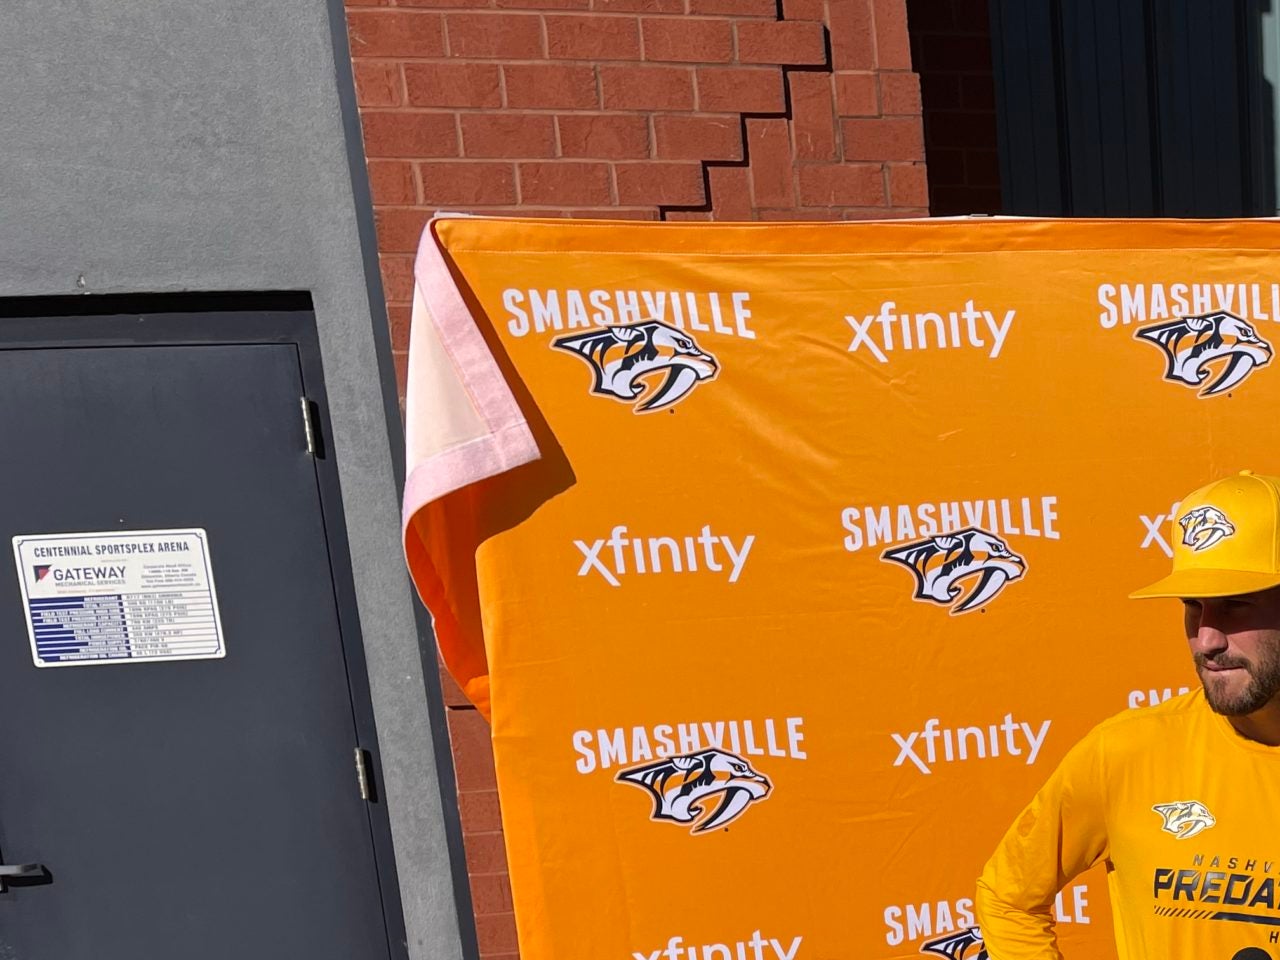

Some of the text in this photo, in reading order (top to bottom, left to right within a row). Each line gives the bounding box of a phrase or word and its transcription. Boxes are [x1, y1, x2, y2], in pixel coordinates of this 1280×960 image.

[502, 287, 757, 340] SMASHVILLE
[844, 299, 1017, 363] xfinity
[34, 540, 190, 558] CENTENNIAL SPORTSPLEX ARENA
[841, 495, 1061, 552] SMASHVILLE
[53, 566, 126, 581] GATEWAY
[573, 524, 756, 587] xfinity
[572, 717, 807, 775] SMASHVILLE
[891, 713, 1052, 775] xfinity
[883, 884, 1090, 946] SMASLE
